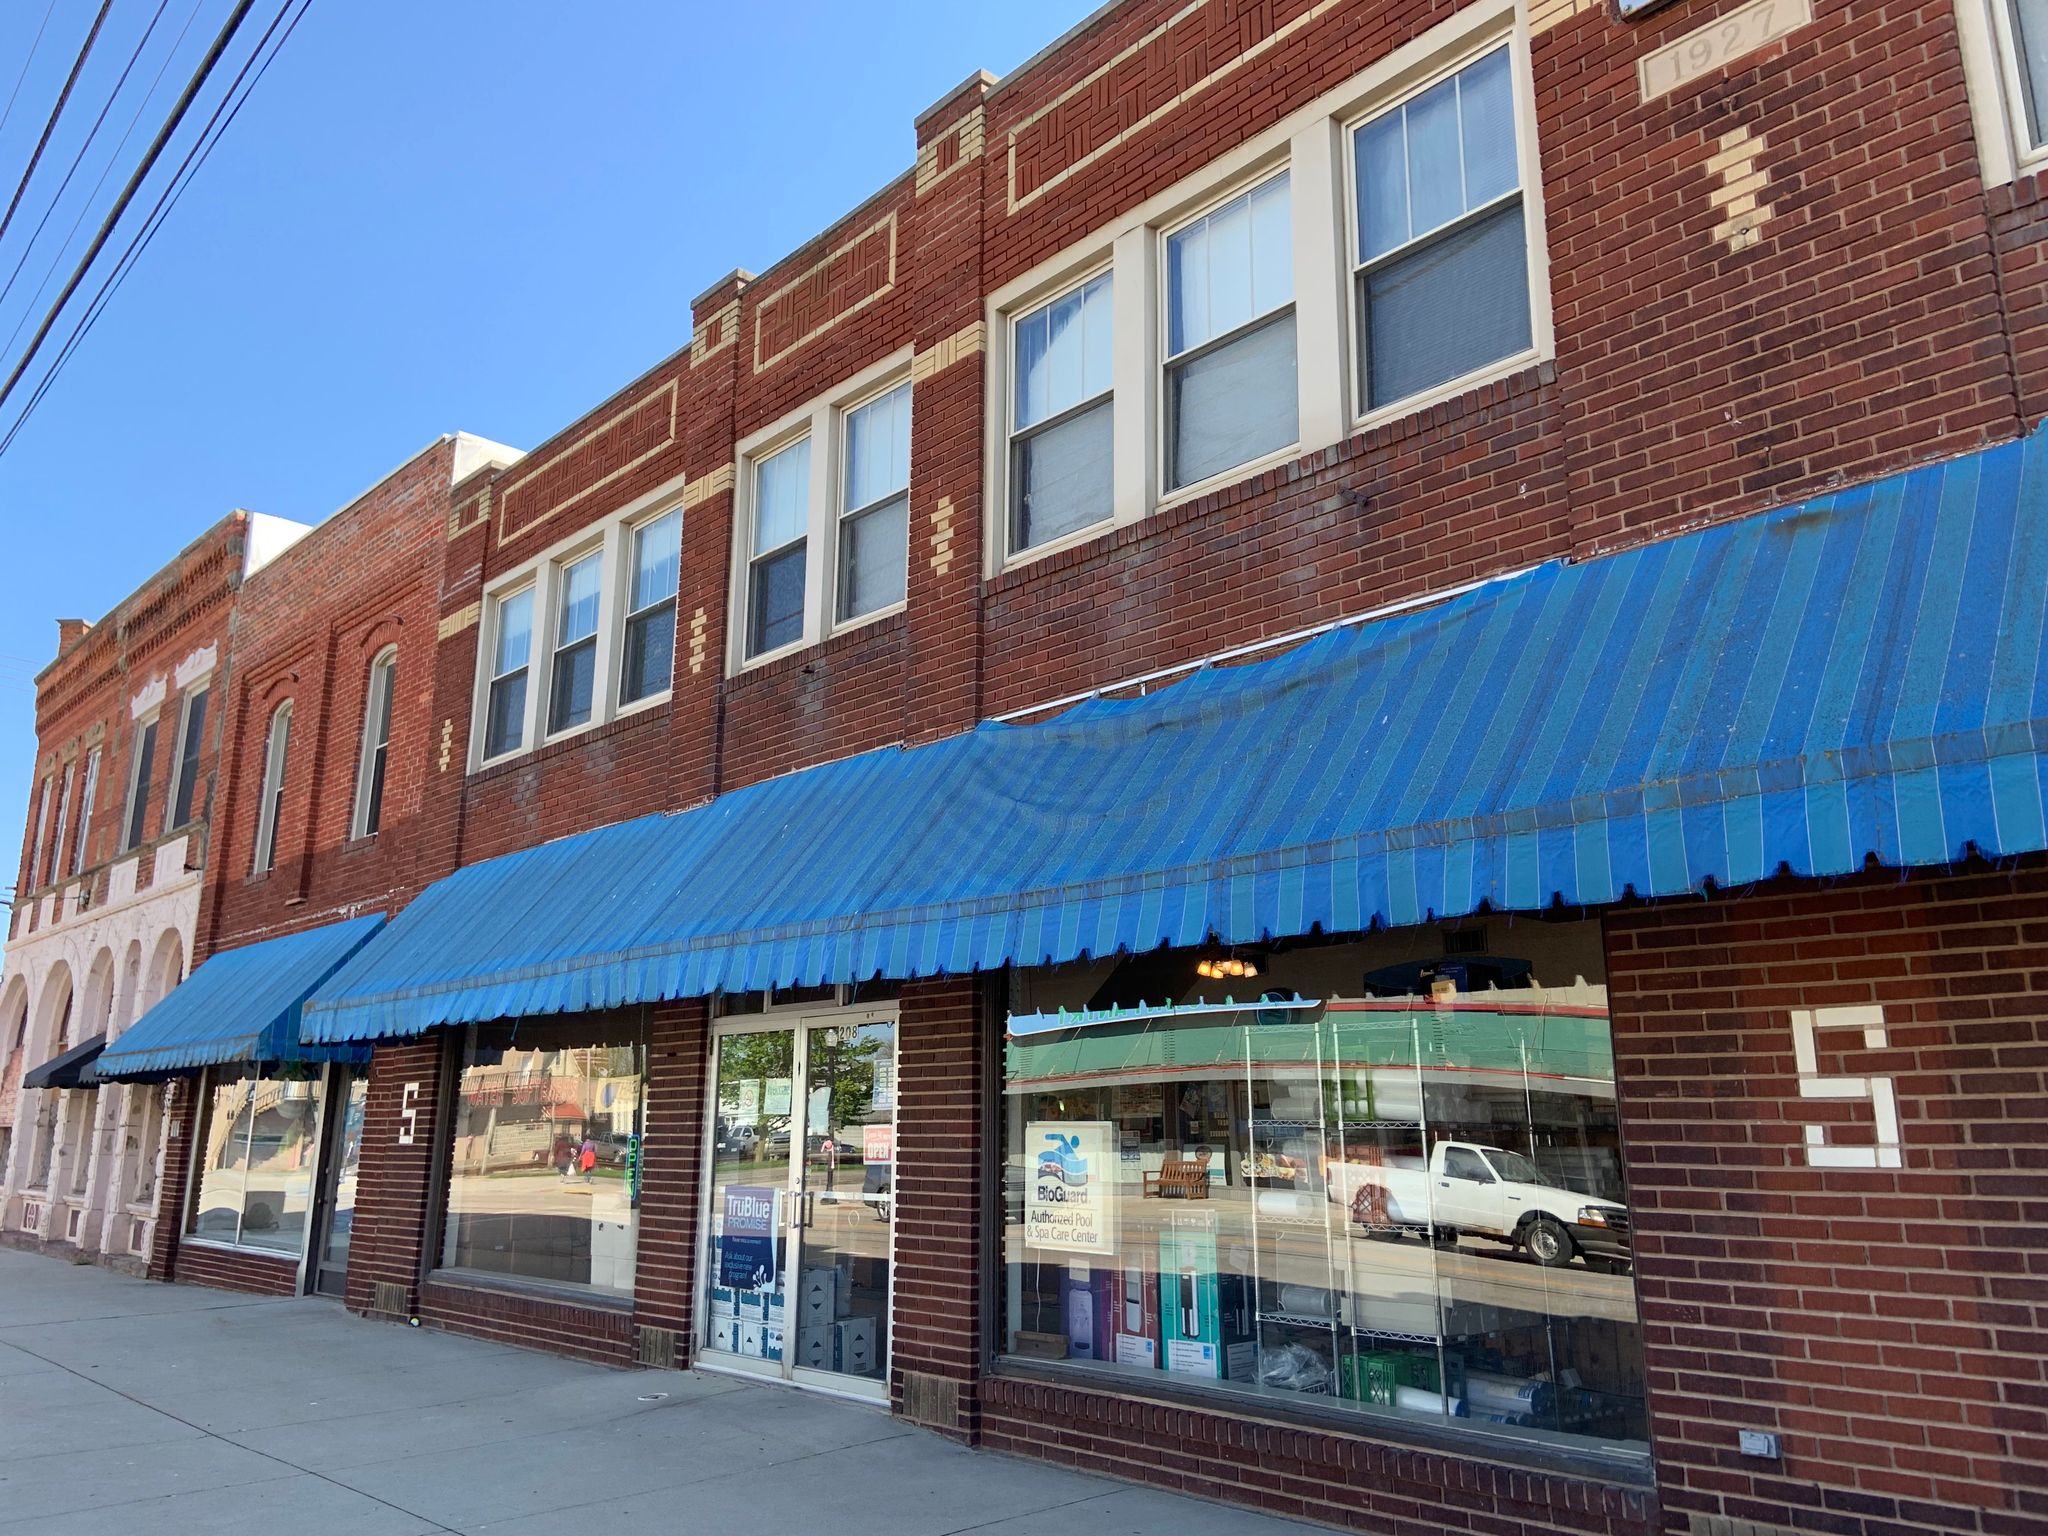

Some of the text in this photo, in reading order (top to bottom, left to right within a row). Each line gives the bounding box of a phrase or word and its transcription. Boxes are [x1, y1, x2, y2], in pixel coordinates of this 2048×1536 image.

[1667, 2, 1776, 82] 1927
[839, 1025, 858, 1040] 208
[867, 1142, 889, 1159] OPEN
[626, 1138, 638, 1197] OPEN
[1037, 1185, 1088, 1204] BioGuard
[727, 1195, 770, 1219] TruBlue
[727, 1217, 768, 1231] PROMISE
[1030, 1210, 1093, 1227] Authorized Pool
[1026, 1226, 1098, 1243] & Spa Care Center
